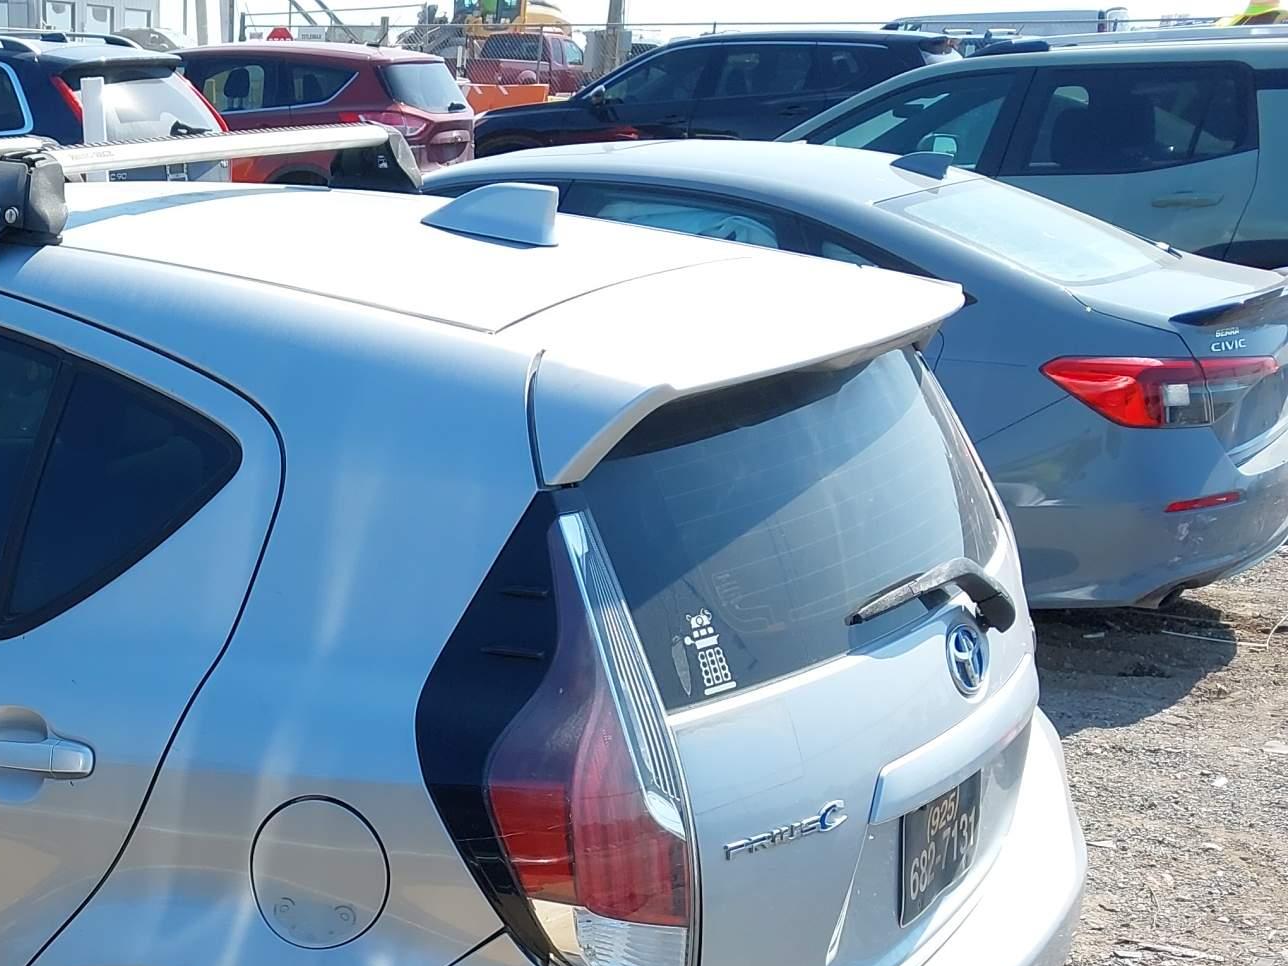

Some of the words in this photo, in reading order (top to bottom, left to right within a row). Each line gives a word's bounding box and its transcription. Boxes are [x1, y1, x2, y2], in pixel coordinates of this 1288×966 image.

[1210, 338, 1247, 352] CIVIC
[926, 784, 960, 844] (925)
[910, 805, 977, 901] 682-7131
